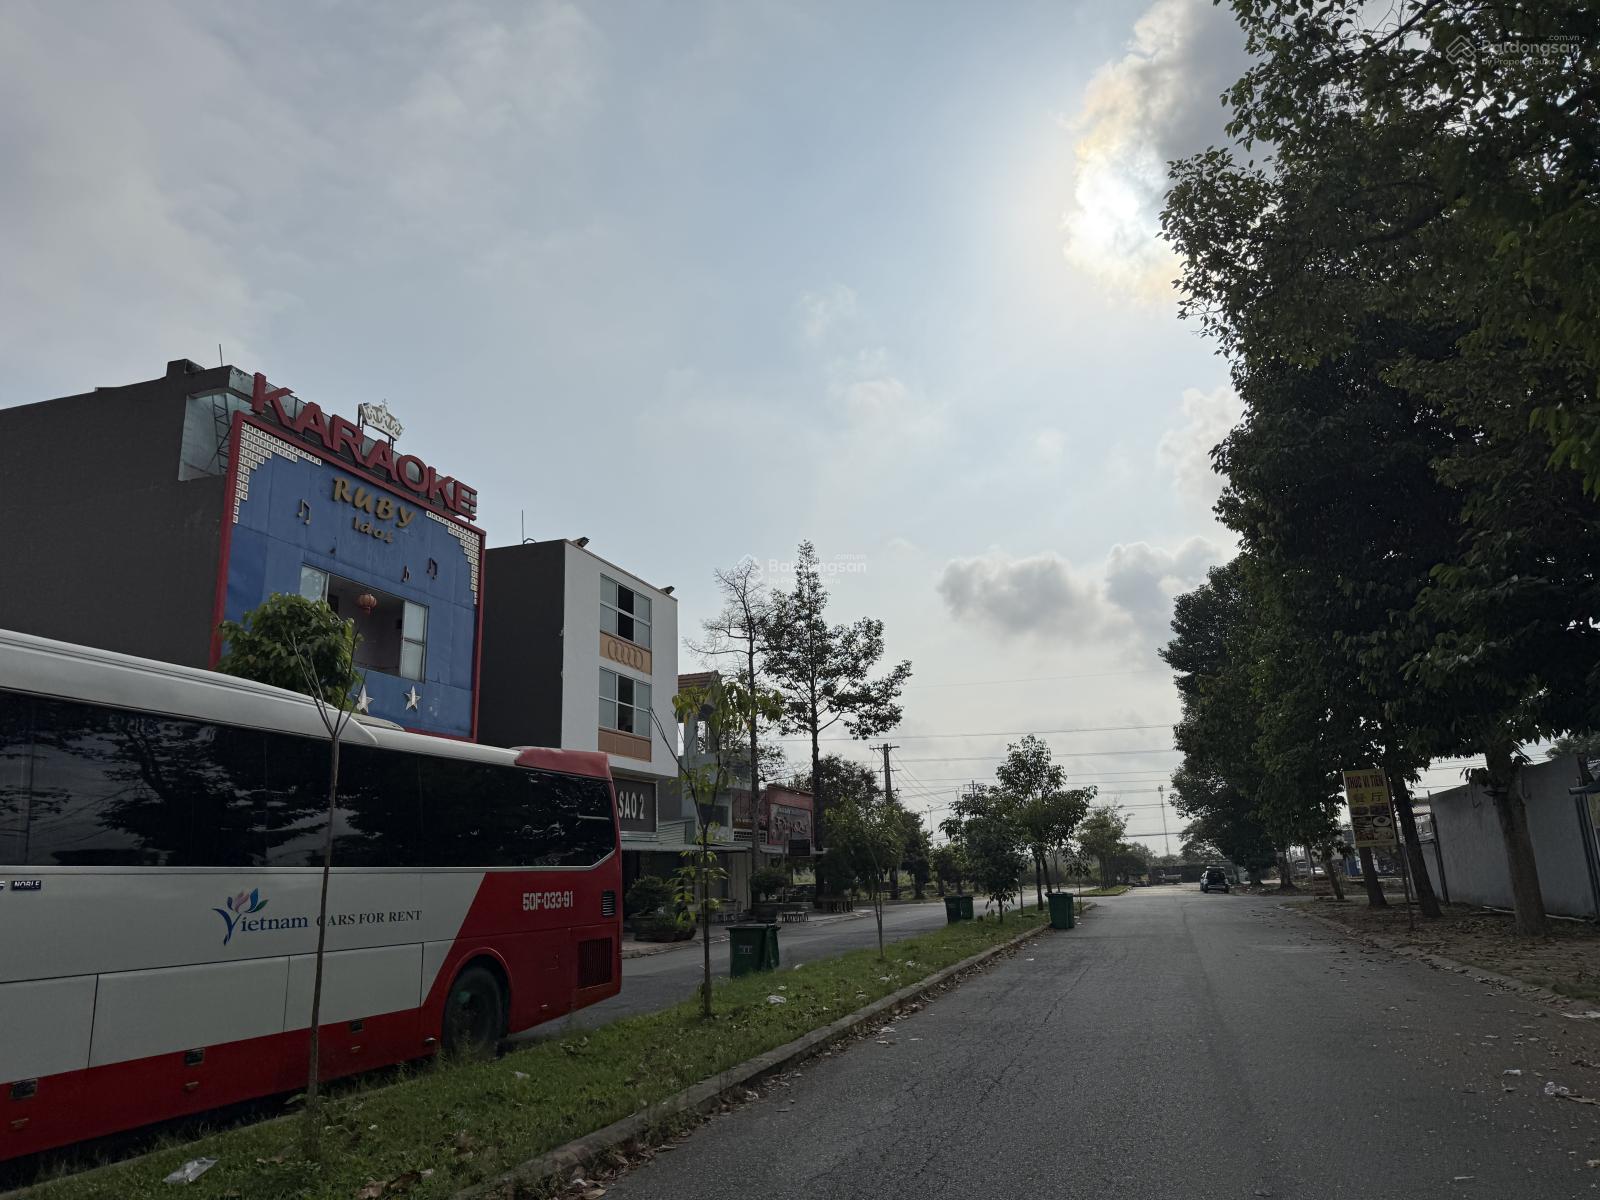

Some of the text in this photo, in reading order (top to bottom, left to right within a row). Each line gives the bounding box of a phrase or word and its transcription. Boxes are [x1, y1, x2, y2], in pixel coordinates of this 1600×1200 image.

[252, 372, 477, 521] KARAOKE
[618, 790, 637, 819] SAO
[212, 907, 308, 946] Vietnam
[358, 911, 385, 924] FOR
[388, 909, 423, 923] RENT
